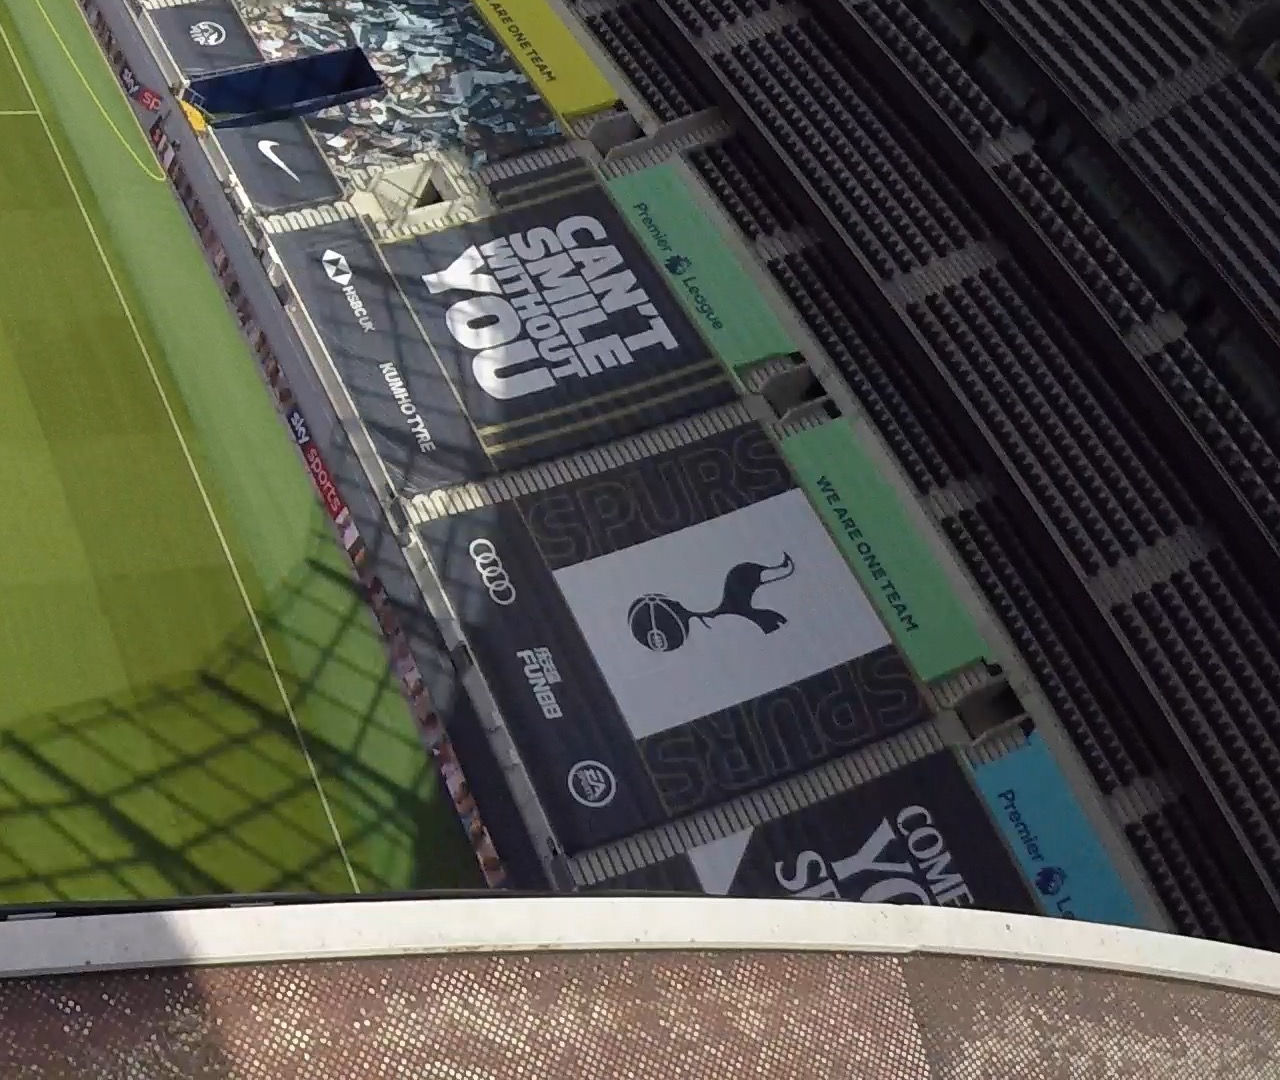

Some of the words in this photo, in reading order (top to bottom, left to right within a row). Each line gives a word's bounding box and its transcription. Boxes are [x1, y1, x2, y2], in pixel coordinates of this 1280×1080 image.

[122, 67, 140, 94] sky
[489, 1, 516, 26] ARE
[507, 24, 534, 50] ONE
[527, 50, 557, 84] TEAM
[342, 285, 367, 319] HSBC
[359, 316, 376, 333] UK
[421, 244, 558, 400] YOU
[478, 236, 590, 380] WITHOUT
[508, 226, 634, 376] SMILE
[556, 215, 679, 352] CAN'T
[633, 201, 674, 253] Premier
[681, 276, 725, 331] League
[290, 411, 310, 445] sky
[307, 447, 340, 512] sports
[379, 361, 416, 416] KUMHO
[406, 410, 437, 454] TYRE
[526, 428, 786, 568] SPURS
[815, 475, 839, 506] WE
[833, 503, 863, 540] ARE
[855, 540, 885, 582] ONE
[878, 581, 920, 633] TEAM
[516, 648, 564, 721] FUN88
[997, 788, 1045, 862] Premier
